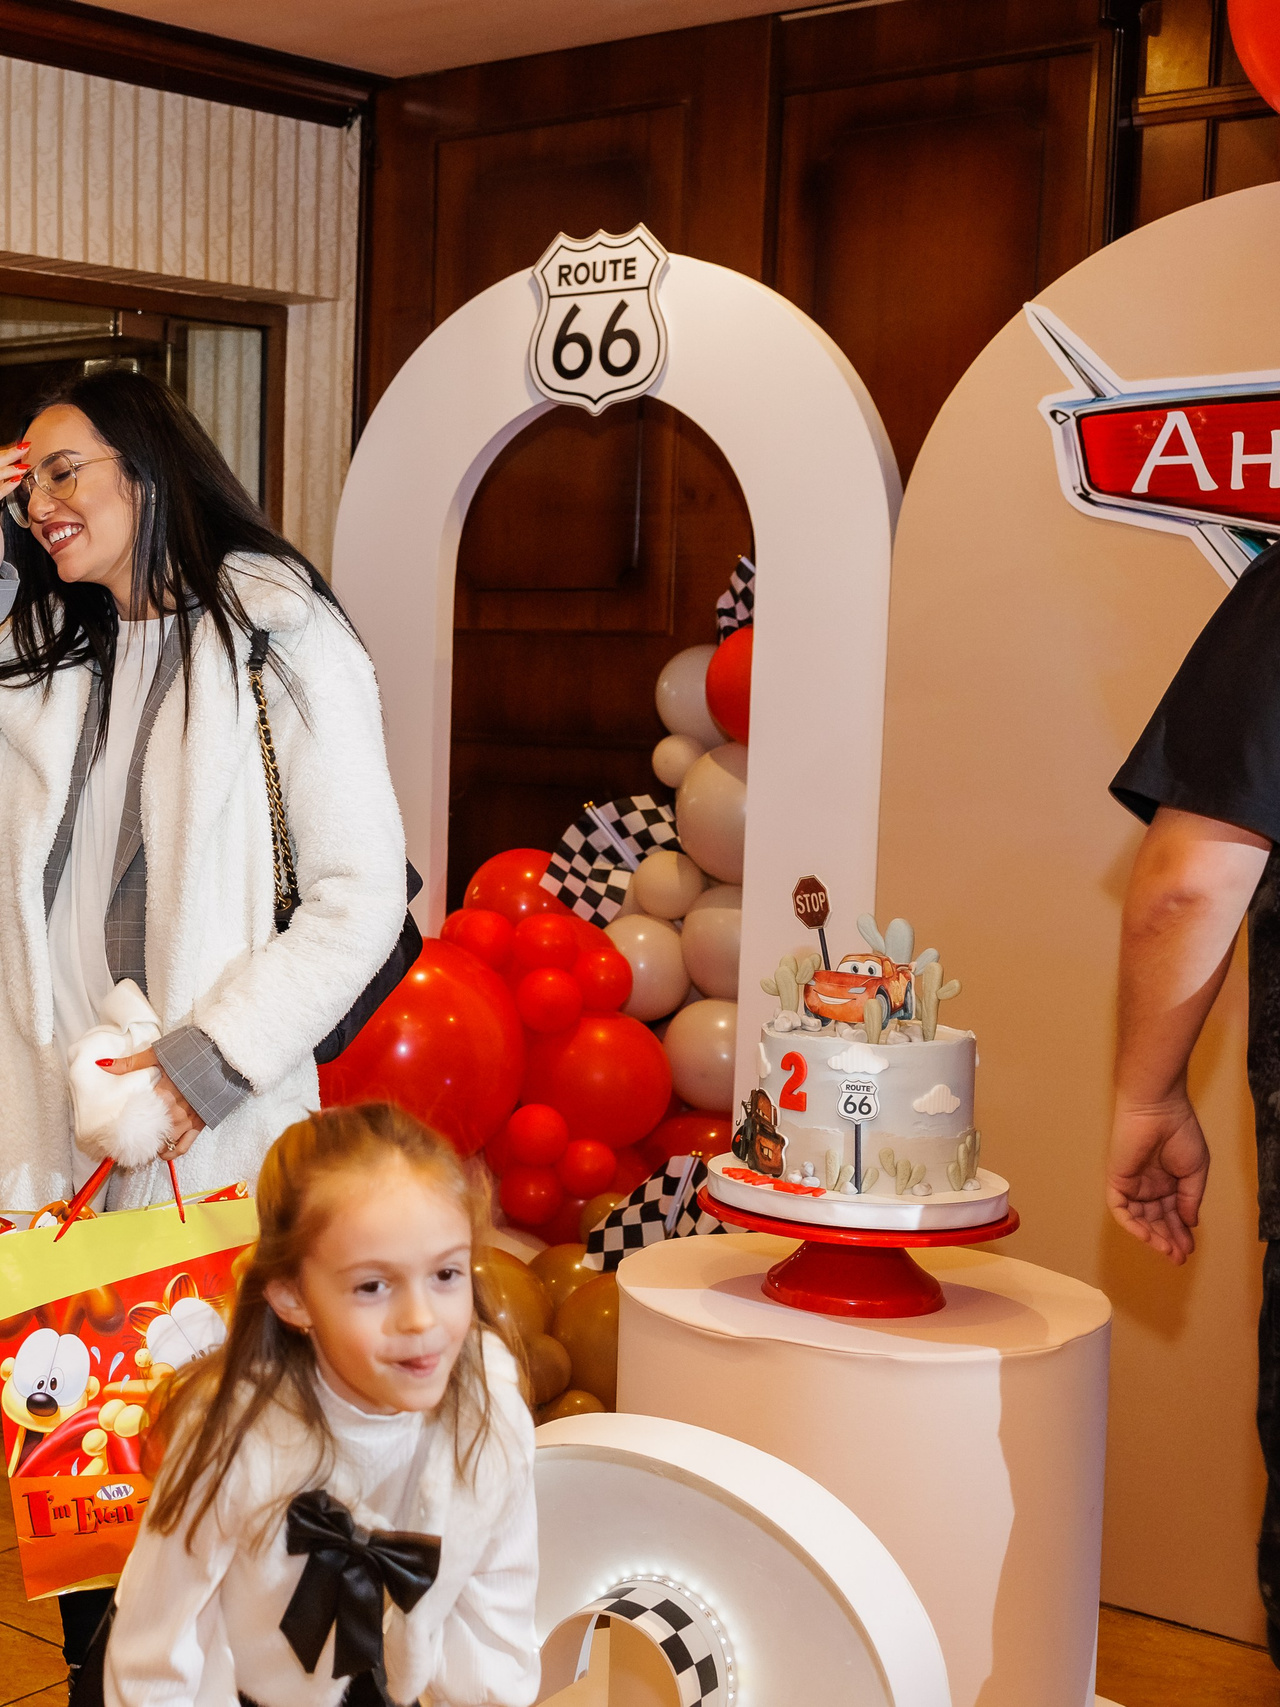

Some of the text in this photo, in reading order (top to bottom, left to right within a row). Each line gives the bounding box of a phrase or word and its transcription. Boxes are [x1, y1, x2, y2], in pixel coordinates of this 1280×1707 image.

[557, 257, 636, 287] ROUTE
[552, 299, 641, 380] 66
[796, 891, 826, 914] STOP
[779, 1051, 808, 1112] 2
[843, 1094, 872, 1115] 66
[22, 1489, 136, 1538] I'm Even
